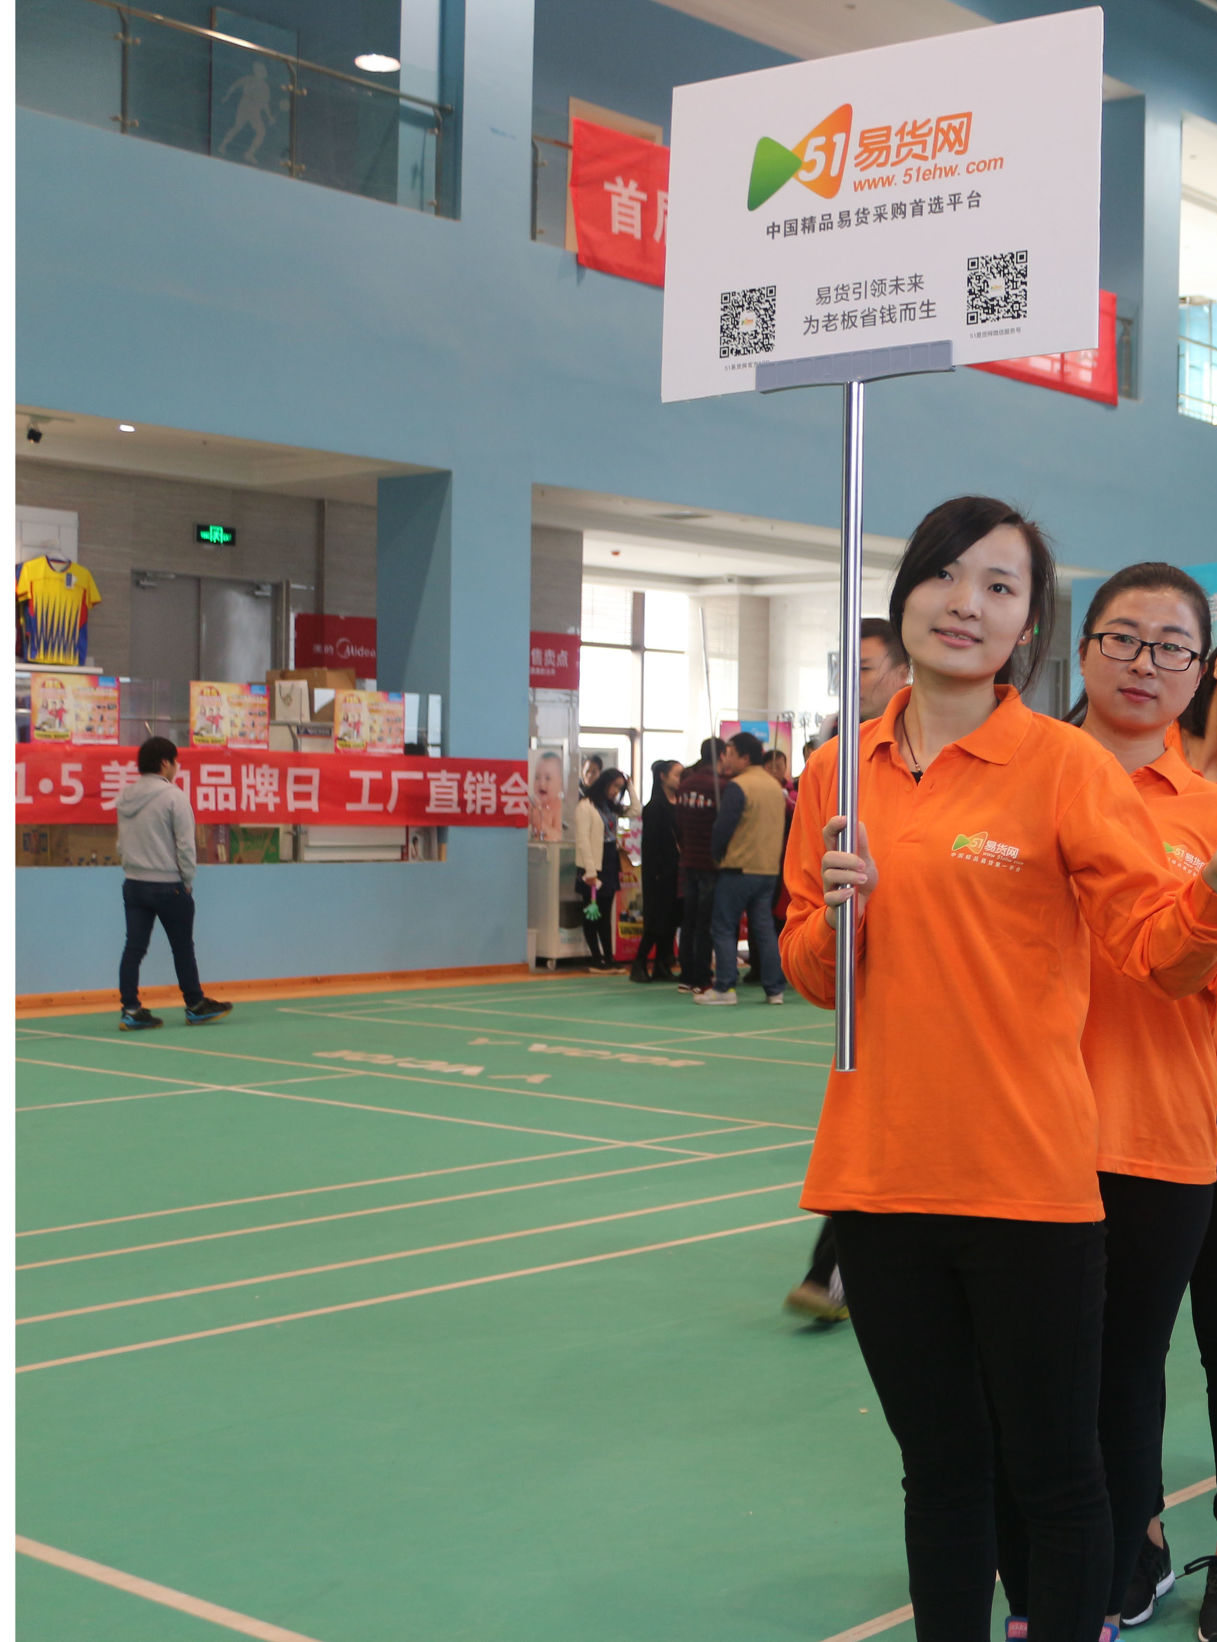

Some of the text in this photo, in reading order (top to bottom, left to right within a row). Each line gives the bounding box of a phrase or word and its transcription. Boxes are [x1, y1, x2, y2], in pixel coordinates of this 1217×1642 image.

[798, 112, 972, 182] 51 易货网
[766, 190, 982, 240] 中国精品易货采购首选平台
[816, 273, 925, 306] 易货引领未来
[803, 299, 937, 336] 为老板省钱而生
[345, 769, 528, 816] 工厂直销会
[984, 840, 1019, 859] 易货网
